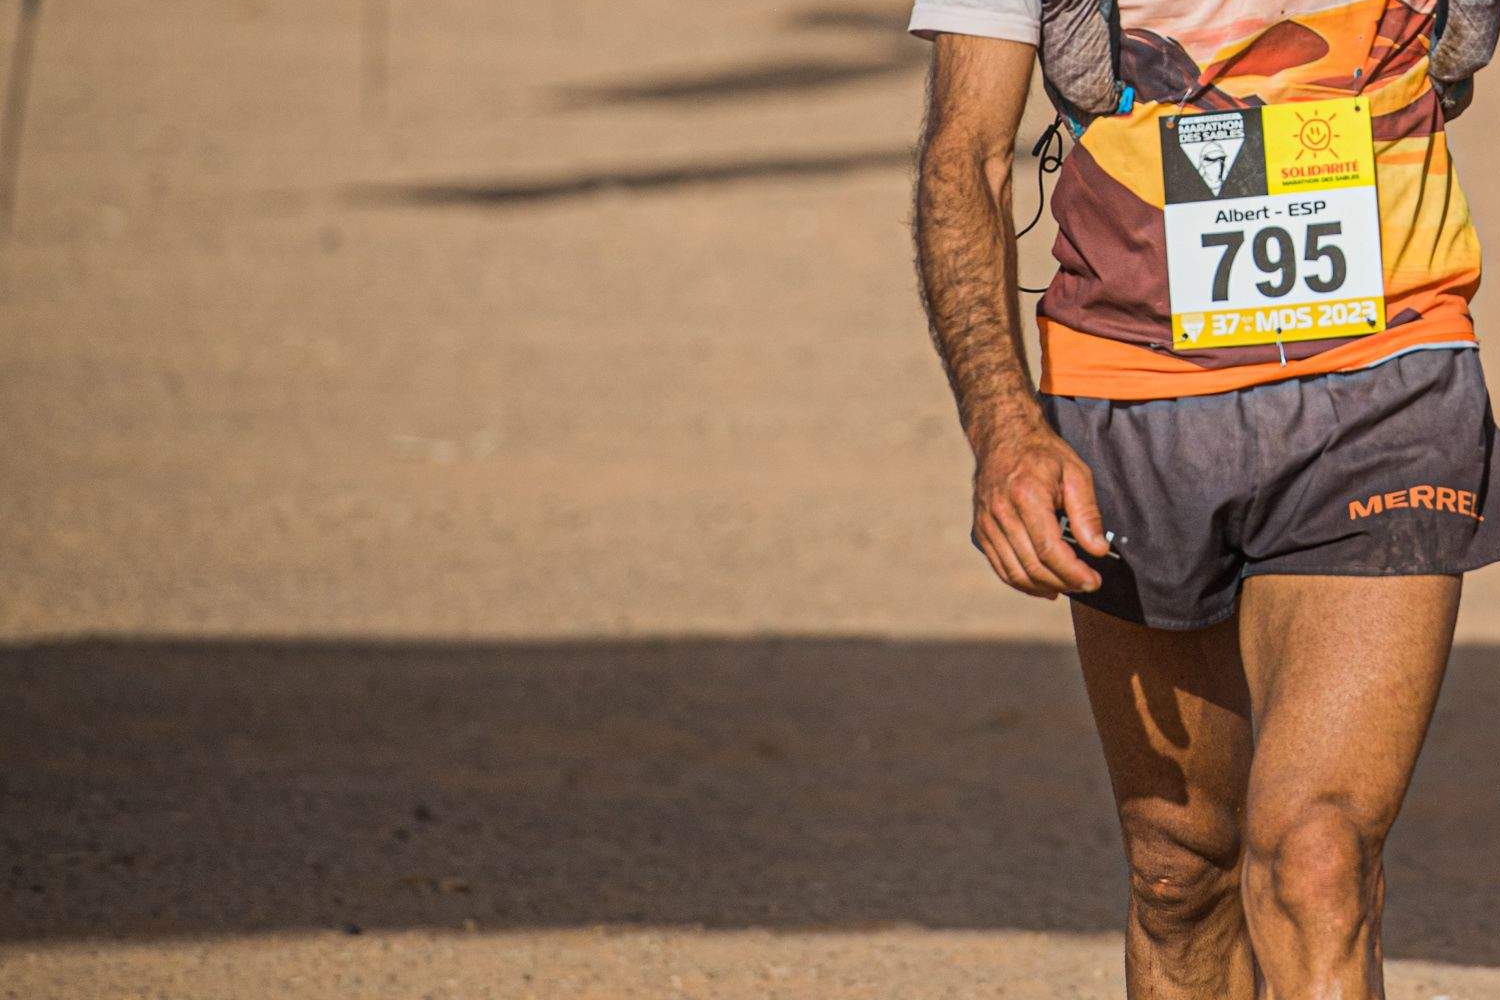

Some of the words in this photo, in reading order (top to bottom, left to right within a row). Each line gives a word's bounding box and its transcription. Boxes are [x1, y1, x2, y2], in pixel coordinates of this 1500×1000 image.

[1178, 119, 1245, 135] MARATHON
[1179, 132, 1202, 144] DES
[1202, 128, 1246, 142] SABLES
[1215, 205, 1270, 224] Albert
[1288, 200, 1326, 218] ESP
[1201, 220, 1348, 303] 795
[1254, 305, 1314, 334] MDS
[1317, 300, 1378, 328] 2023
[1347, 483, 1486, 522] MERREL
